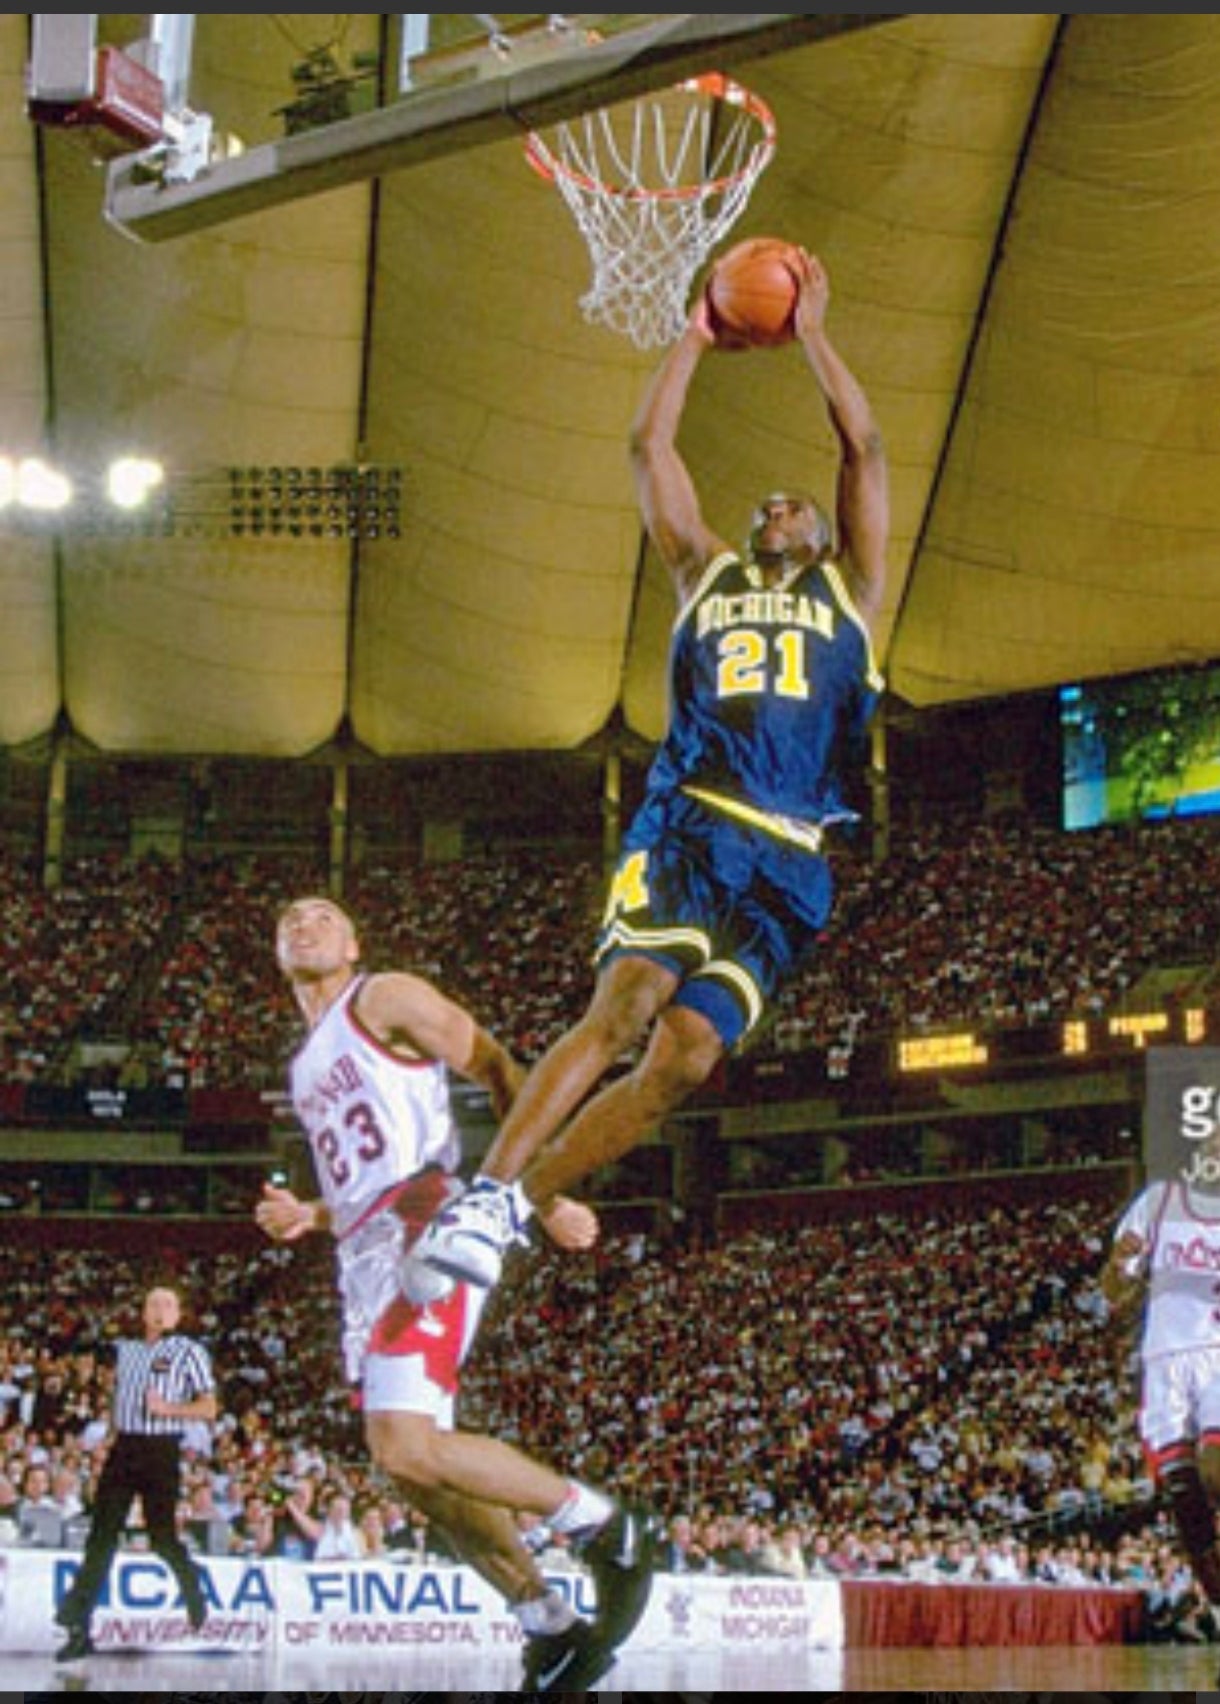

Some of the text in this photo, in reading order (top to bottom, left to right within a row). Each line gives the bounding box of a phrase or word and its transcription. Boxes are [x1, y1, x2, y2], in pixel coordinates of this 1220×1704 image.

[696, 592, 834, 640] MICHIGAN
[717, 628, 810, 700] 21
[317, 1101, 388, 1187] 23
[53, 1560, 275, 1610] NCAA
[307, 1571, 480, 1614] FINAL
[284, 1621, 319, 1645] OF
